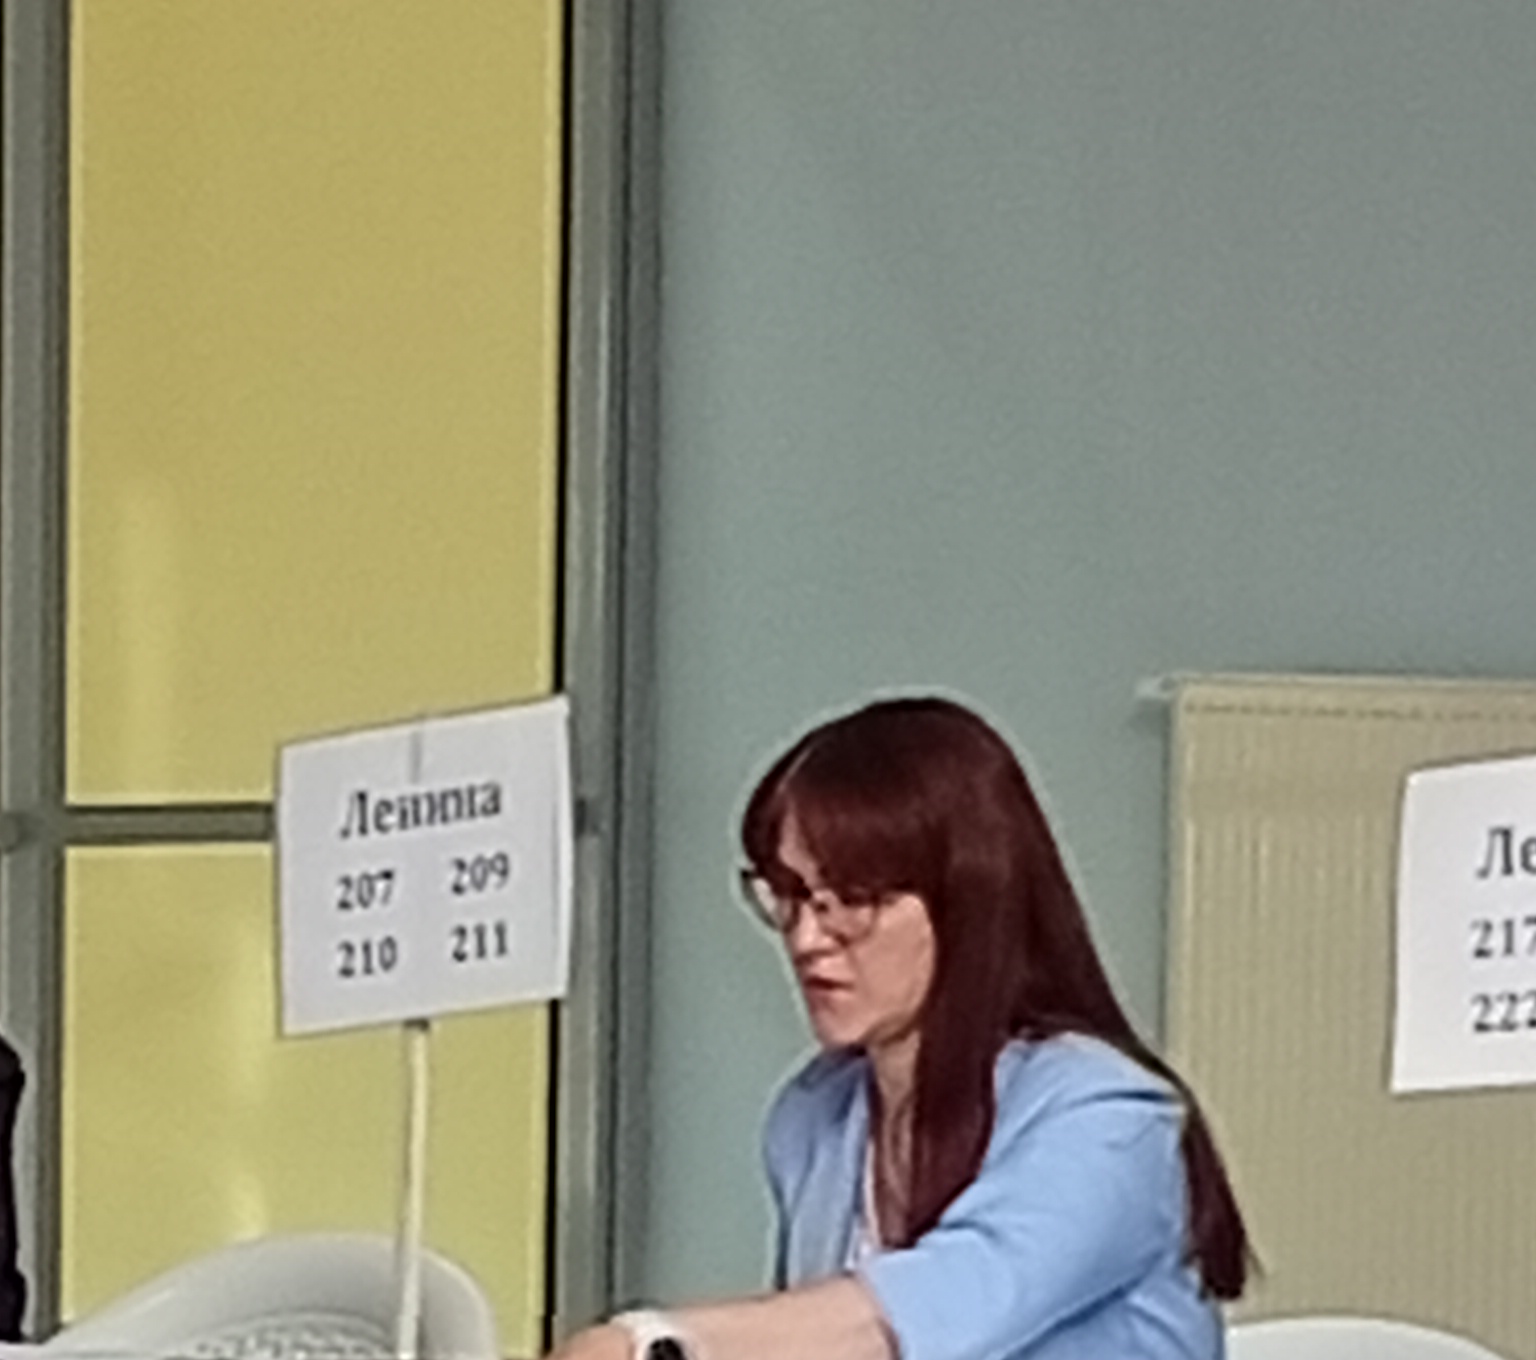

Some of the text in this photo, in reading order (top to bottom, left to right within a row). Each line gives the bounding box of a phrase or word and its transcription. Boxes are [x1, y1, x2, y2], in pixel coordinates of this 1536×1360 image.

[339, 781, 502, 840] Ленина
[336, 851, 510, 911] 207 209
[337, 919, 508, 979] 210 211
